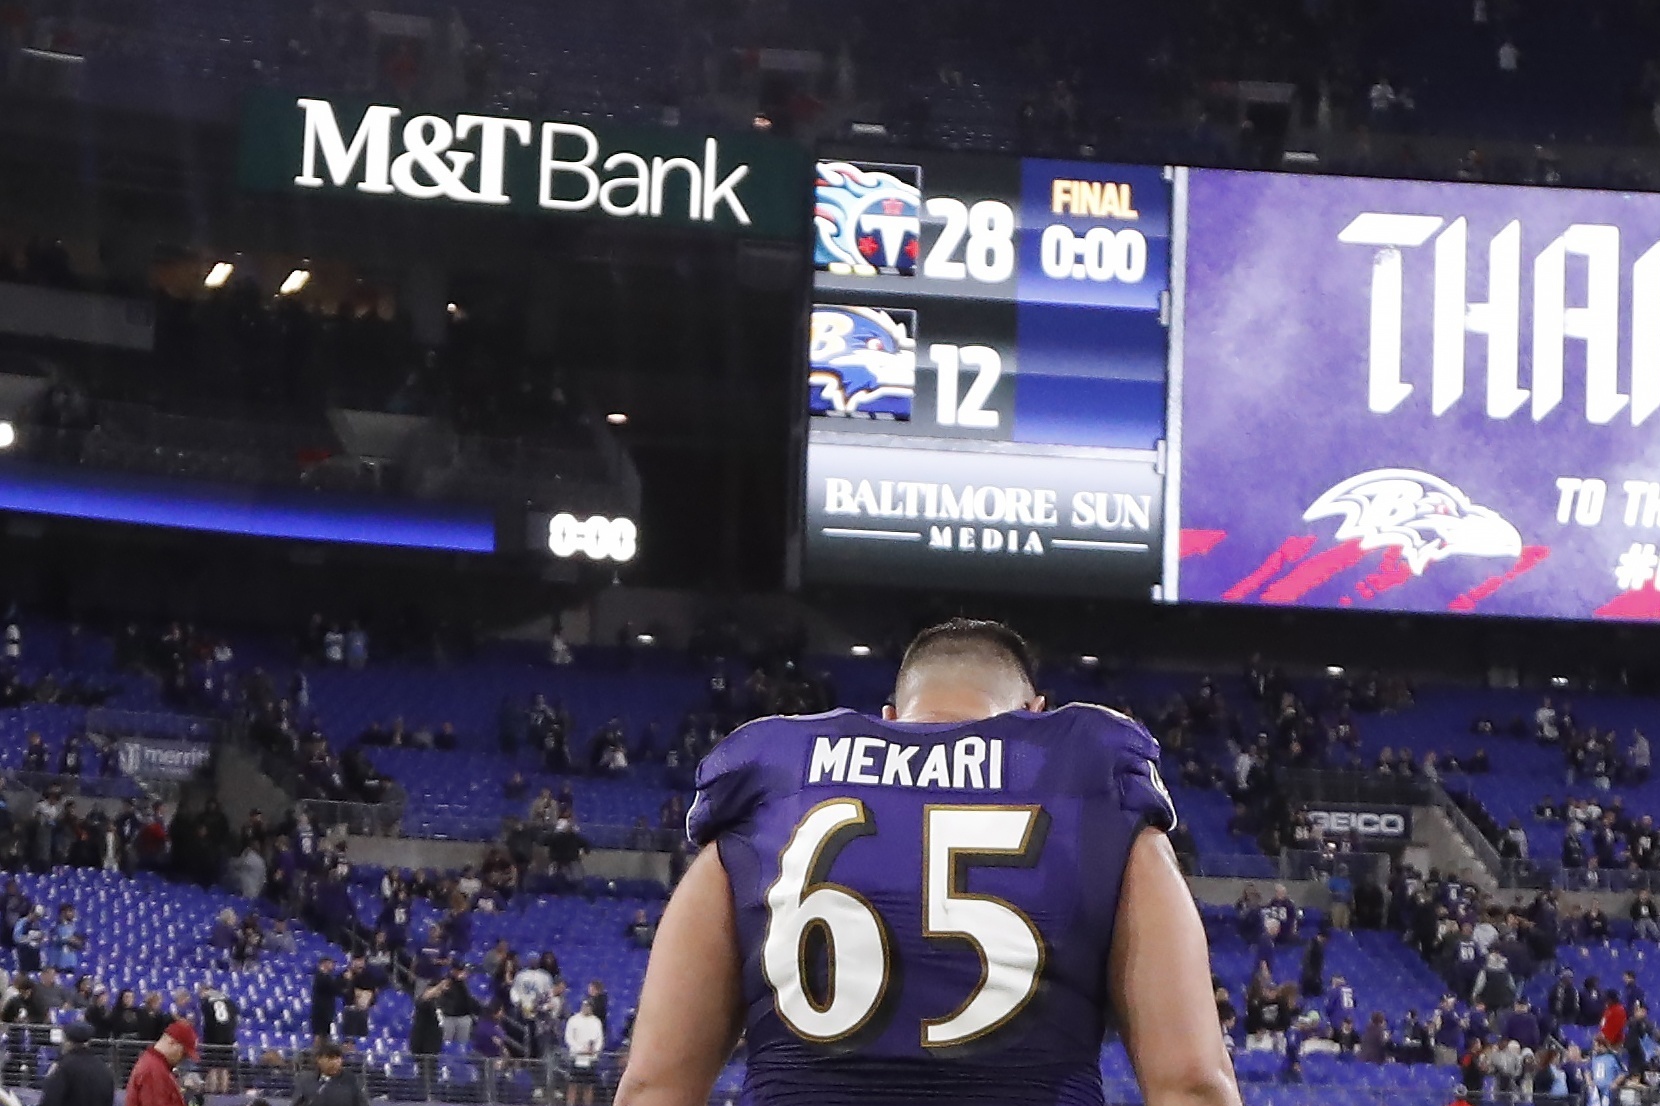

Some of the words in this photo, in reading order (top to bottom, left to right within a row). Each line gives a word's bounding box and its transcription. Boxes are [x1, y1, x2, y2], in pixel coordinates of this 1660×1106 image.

[294, 98, 531, 206] M&T
[538, 121, 752, 226] Bank
[1051, 178, 1139, 219] FINAL
[923, 196, 1017, 284] 28
[1041, 224, 1147, 283] 0:00
[929, 343, 1003, 429] 12
[824, 476, 1059, 527] BALTIMORE
[1072, 491, 1153, 532] SUN
[1554, 475, 1605, 527] TO
[929, 524, 1044, 555] MEDIA
[808, 736, 1003, 790] MEKARI
[762, 797, 1049, 1049] 65
